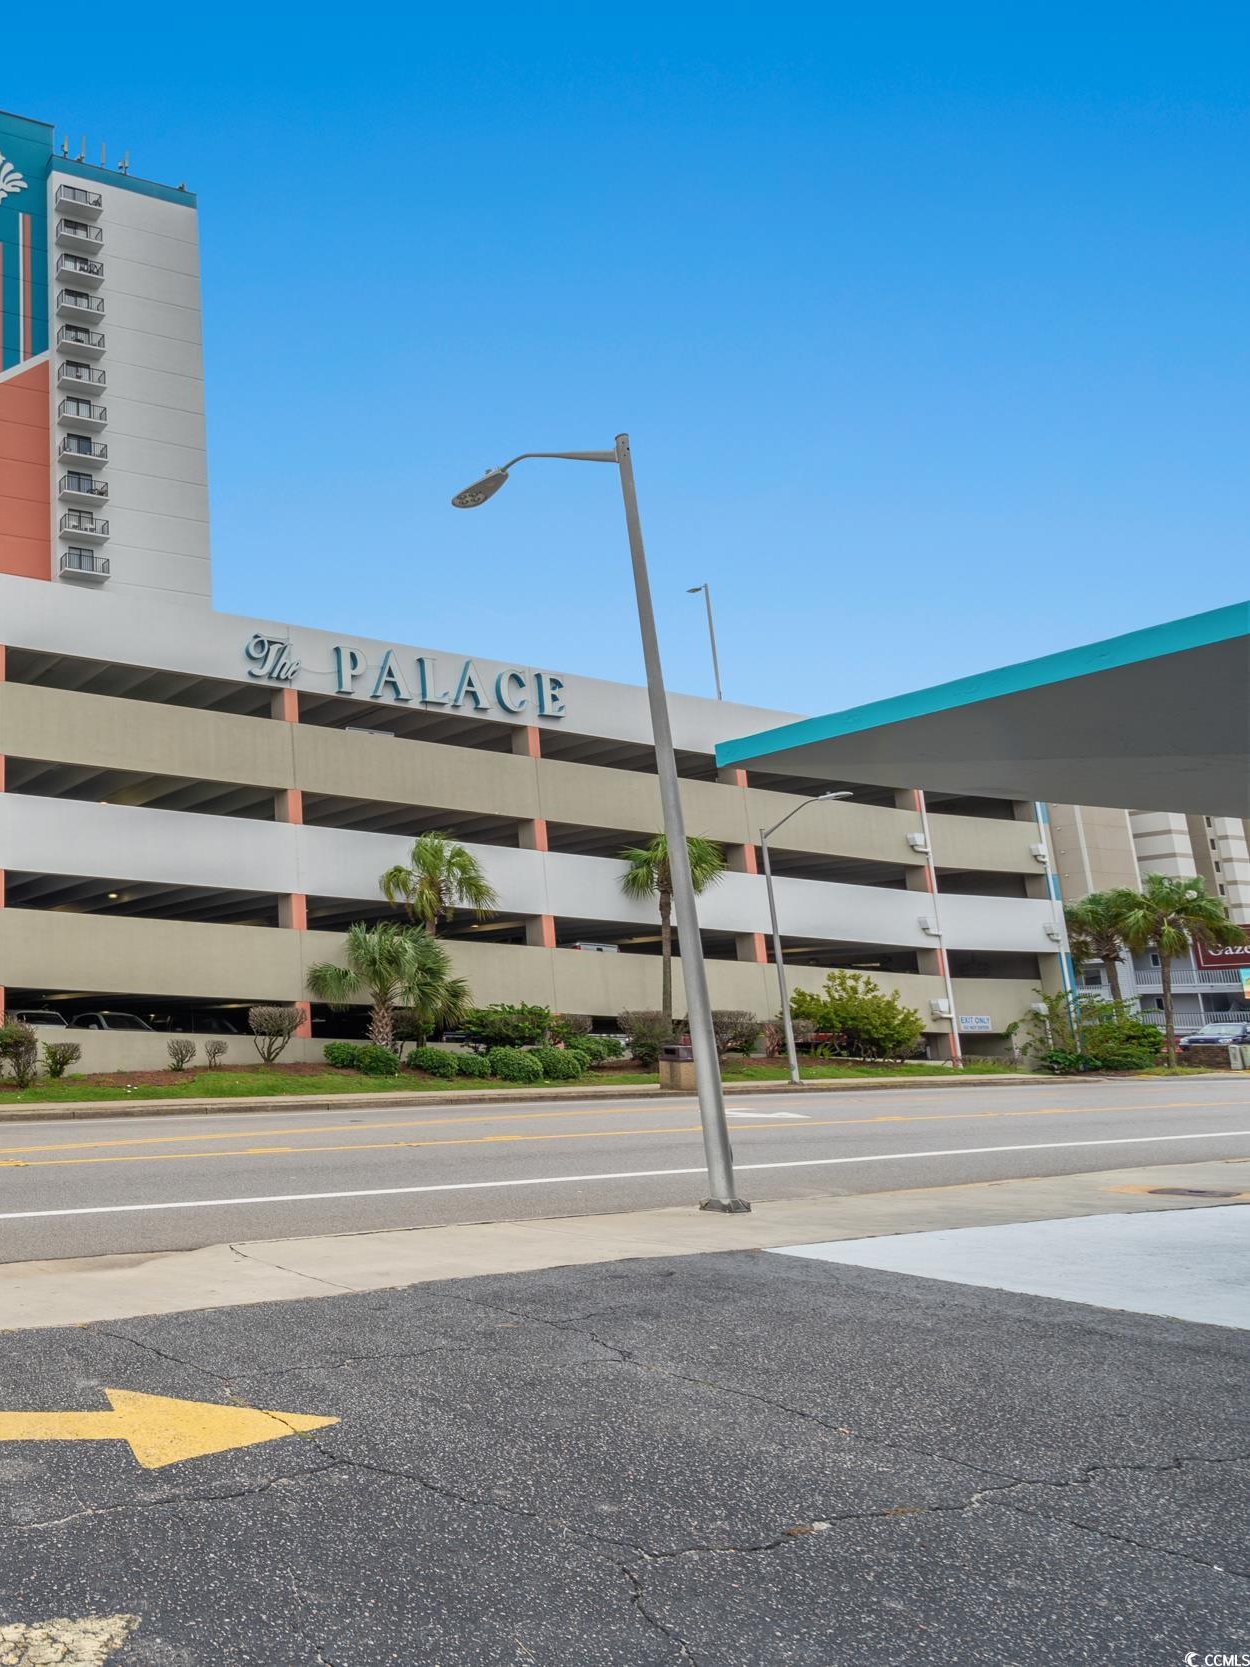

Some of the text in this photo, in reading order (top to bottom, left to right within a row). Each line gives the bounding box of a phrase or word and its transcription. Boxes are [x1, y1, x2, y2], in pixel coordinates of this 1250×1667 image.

[245, 633, 567, 718] The PALACE
[960, 1016, 990, 1025] EXIT ONLY
